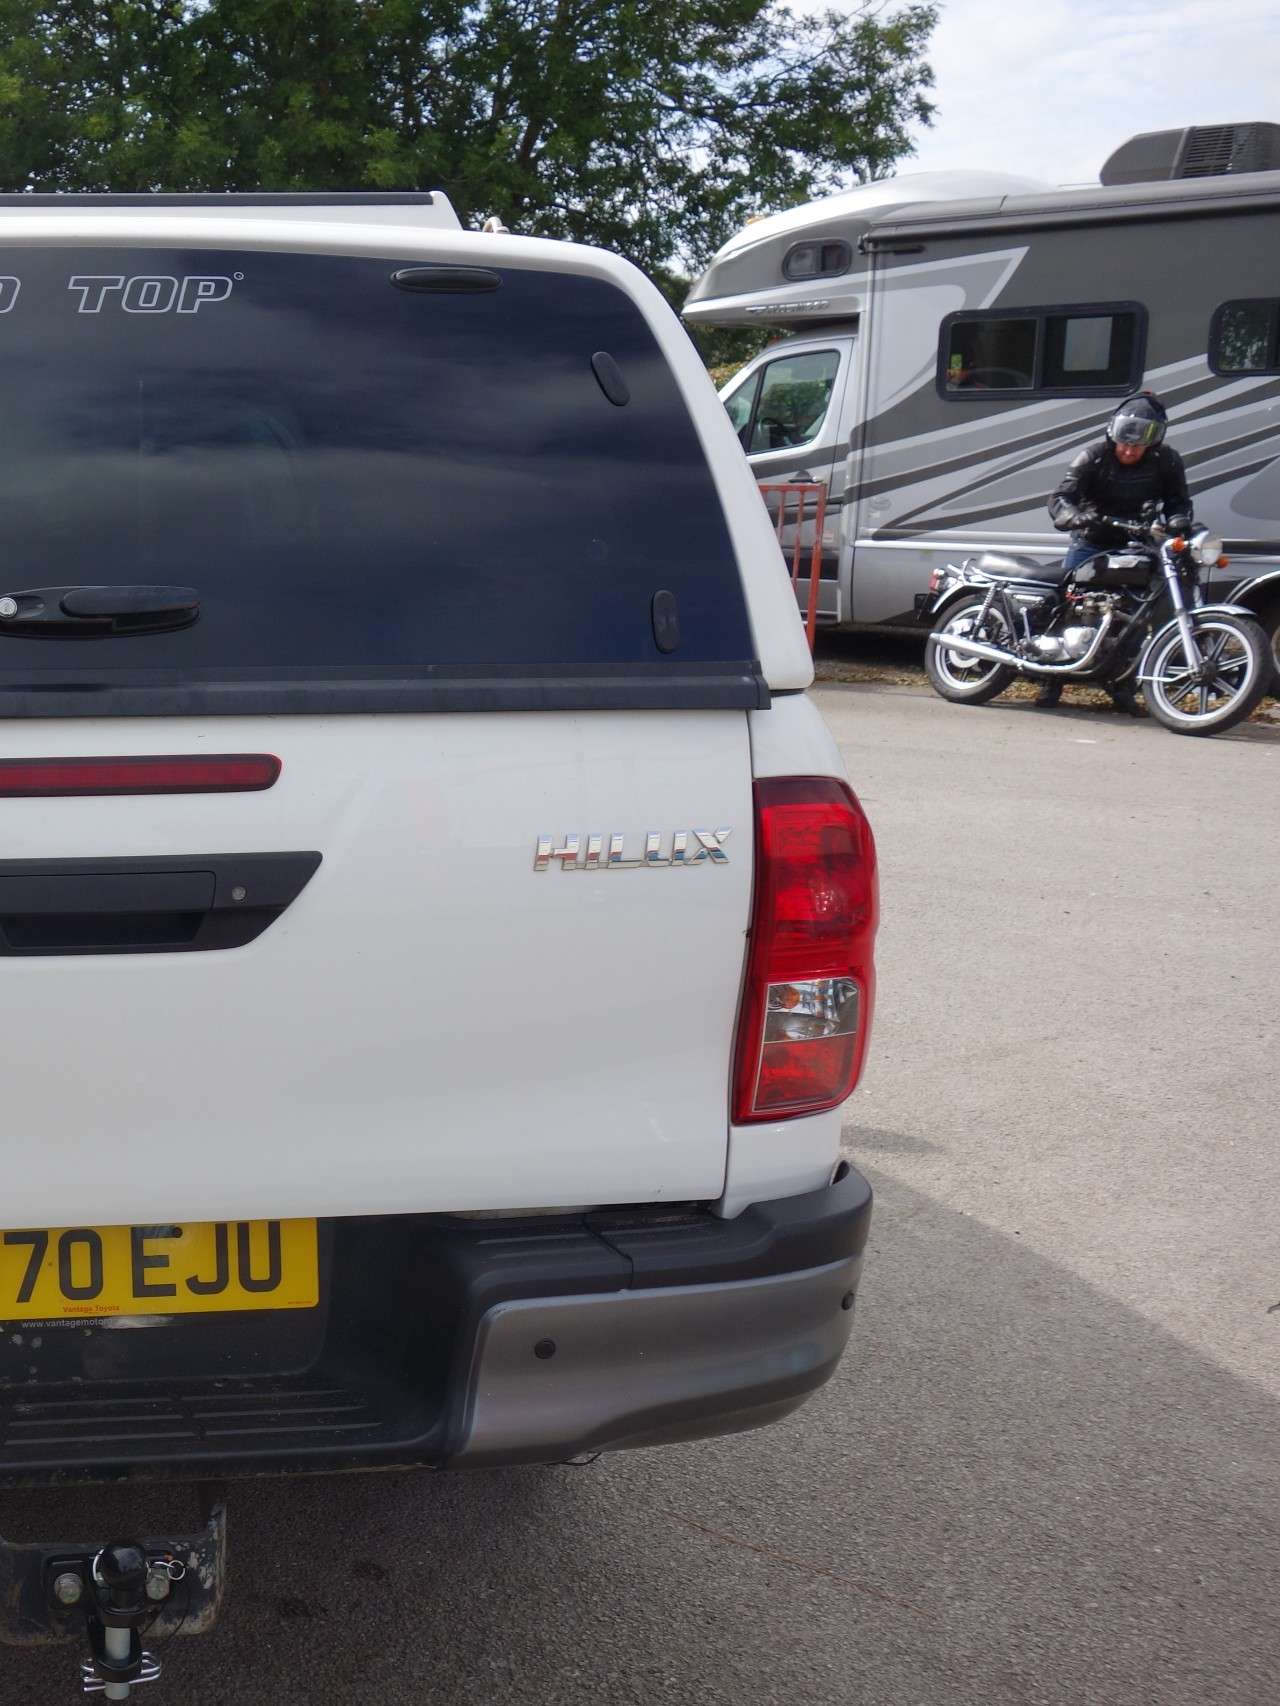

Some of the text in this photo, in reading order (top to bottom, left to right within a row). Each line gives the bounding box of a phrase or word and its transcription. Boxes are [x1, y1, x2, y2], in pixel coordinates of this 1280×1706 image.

[533, 826, 733, 872] HILUX
[131, 1220, 282, 1298] EJU
[63, 1303, 120, 1314] Vantage Toyota
